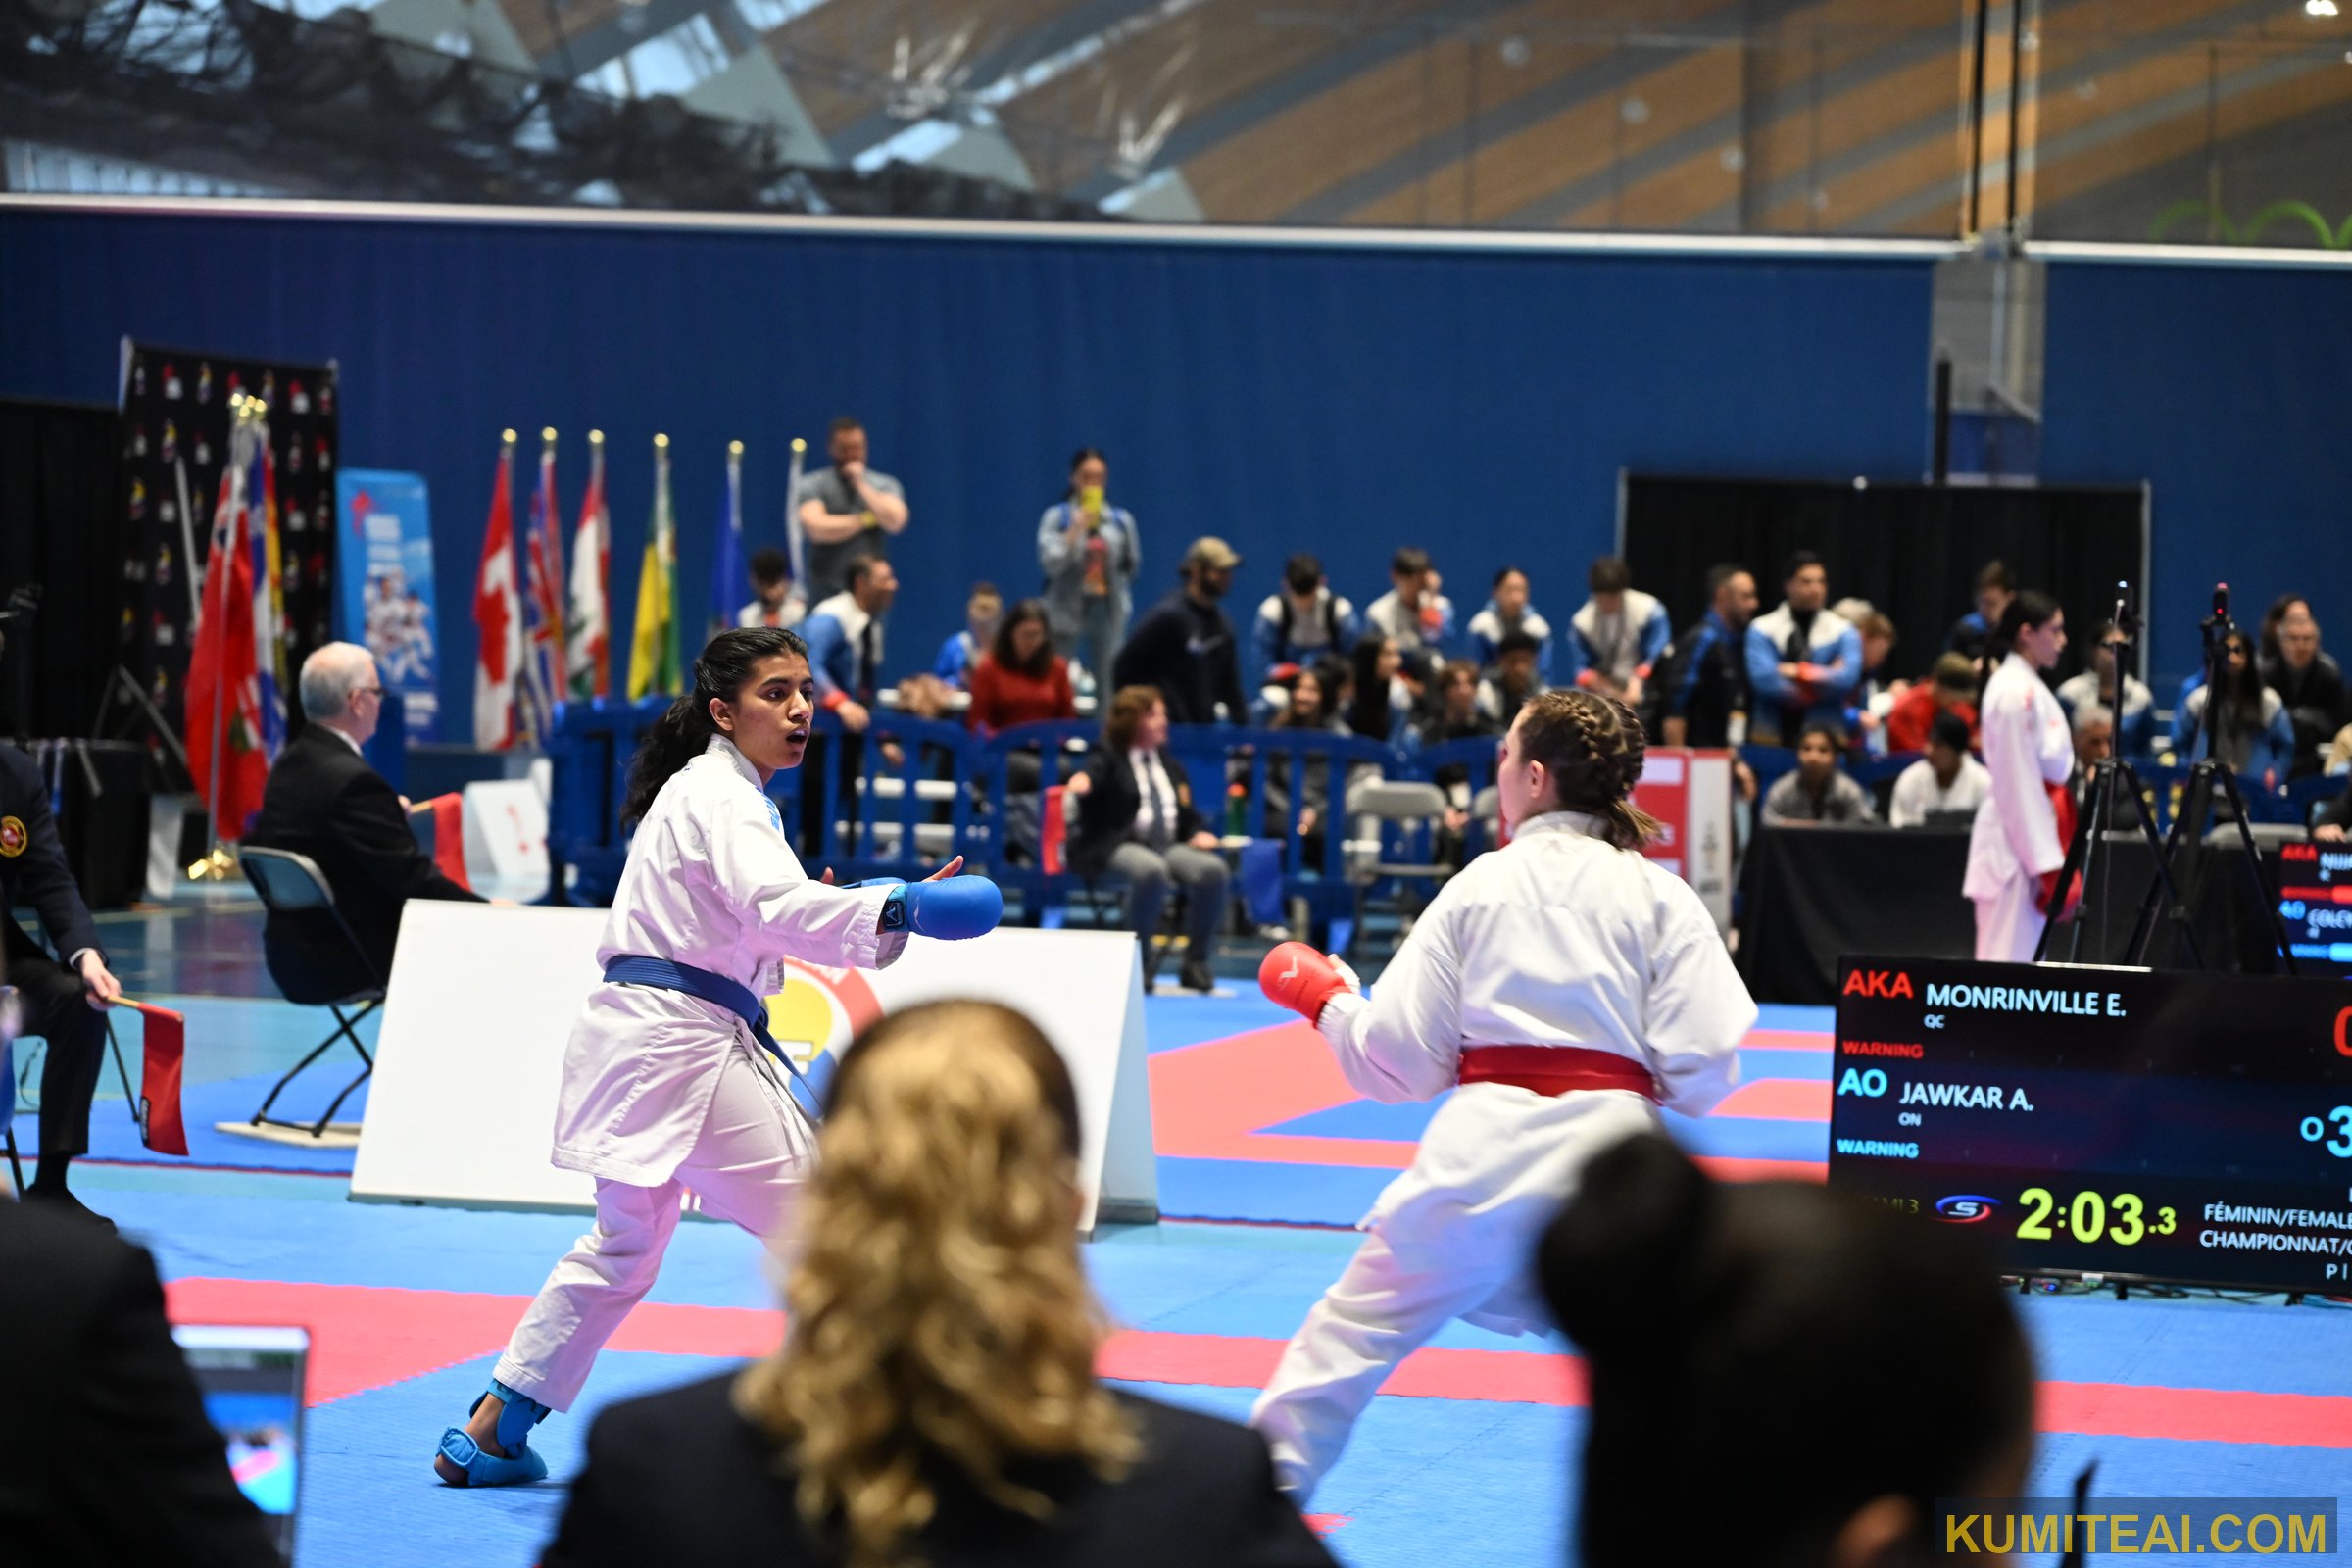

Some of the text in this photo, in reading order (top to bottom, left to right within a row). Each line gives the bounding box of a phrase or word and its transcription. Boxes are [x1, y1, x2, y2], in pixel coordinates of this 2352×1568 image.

[1842, 969, 1914, 999] AKA
[1926, 983, 2127, 1017] MONRINVILLE E.
[1924, 1014, 1945, 1029] QC
[1842, 1040, 1925, 1059] WARNING
[1837, 1067, 1888, 1098] AO
[1898, 1081, 2034, 1111] JAWKAR A.
[1898, 1112, 1922, 1127] ON
[1836, 1139, 1920, 1159] WARNING
